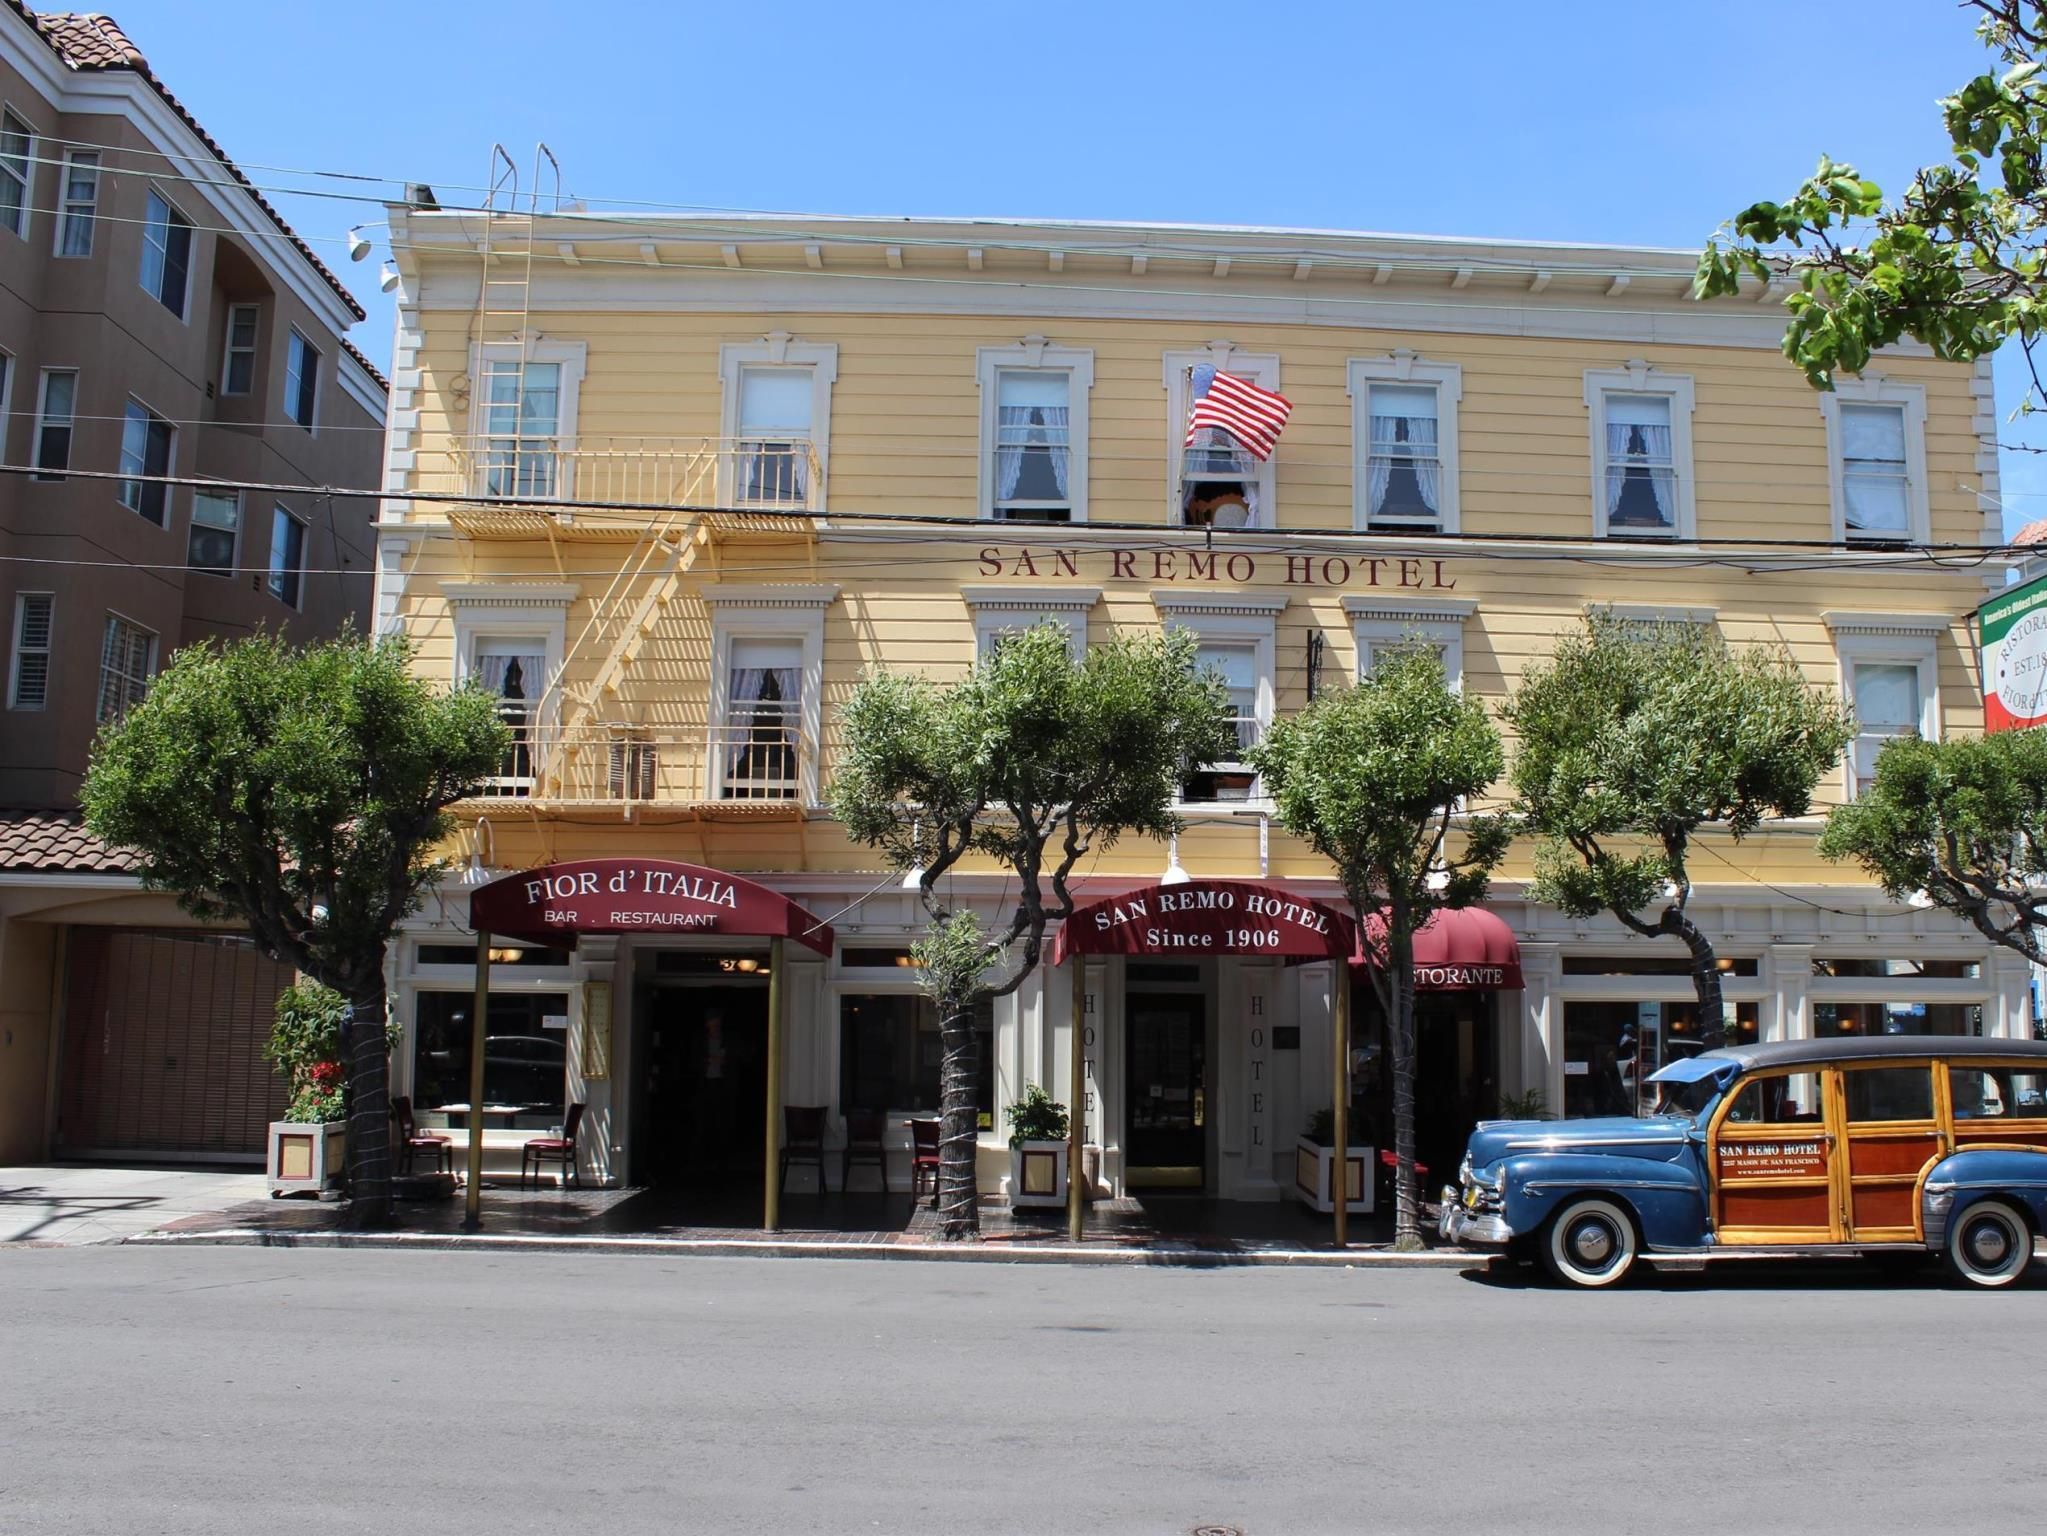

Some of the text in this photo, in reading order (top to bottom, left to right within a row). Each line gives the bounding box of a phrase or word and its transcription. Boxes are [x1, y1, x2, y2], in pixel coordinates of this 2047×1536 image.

[979, 547, 1457, 590] SAN REMO HOTEL
[525, 870, 737, 908] FIOR d' ITALIA
[544, 911, 718, 927] BAR RESTAURANT
[1095, 892, 1330, 935] SAN REMO HOTEL
[1146, 929, 1280, 947] Since 1906
[1083, 994, 1095, 1145] HOTEL
[1251, 996, 1263, 1146] HOTEL
[1720, 1143, 1820, 1156] SAN REMO HOTEL
[1771, 1158, 1783, 1166] SAN
